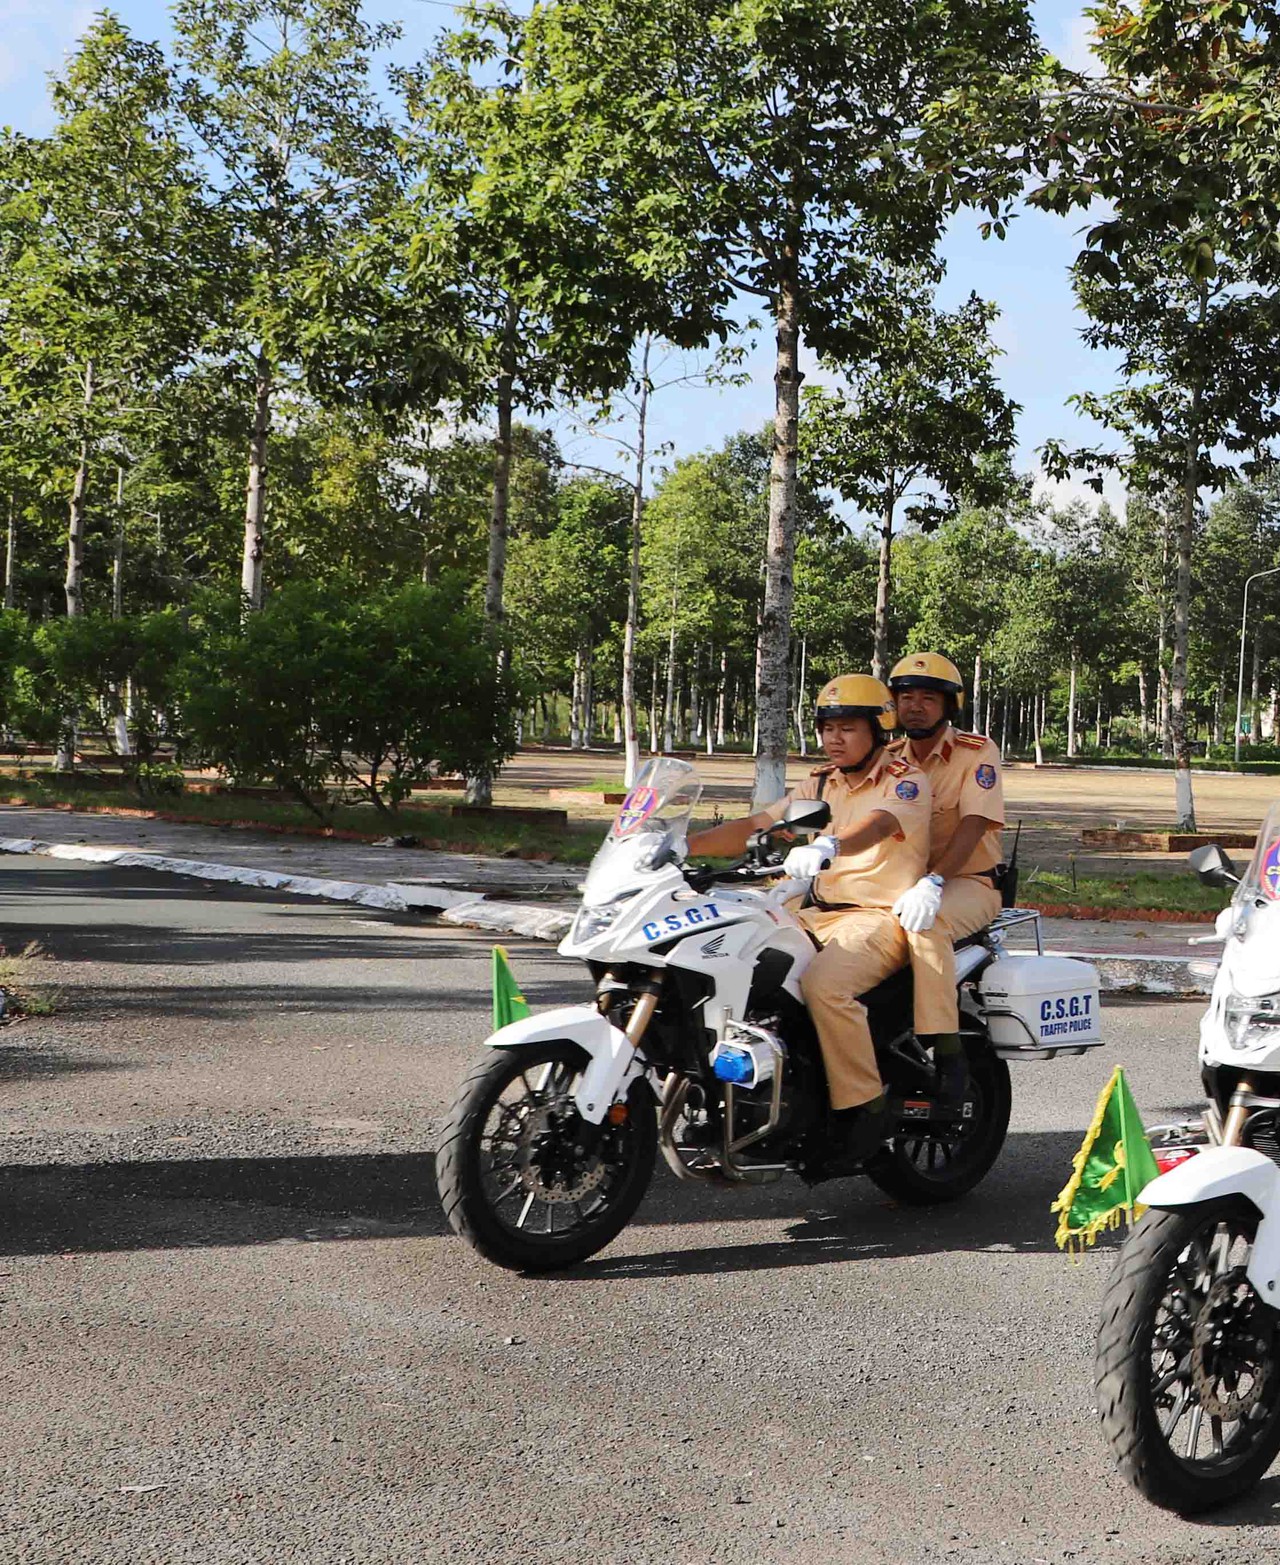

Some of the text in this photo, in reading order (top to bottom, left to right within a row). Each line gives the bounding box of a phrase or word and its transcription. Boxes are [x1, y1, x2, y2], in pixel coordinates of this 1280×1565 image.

[642, 903, 719, 940] C.S.G.T
[701, 952, 730, 960] HONDA
[1040, 994, 1092, 1021] C.S.G.T
[1040, 1018, 1092, 1037] TRAFFIC POLICE
